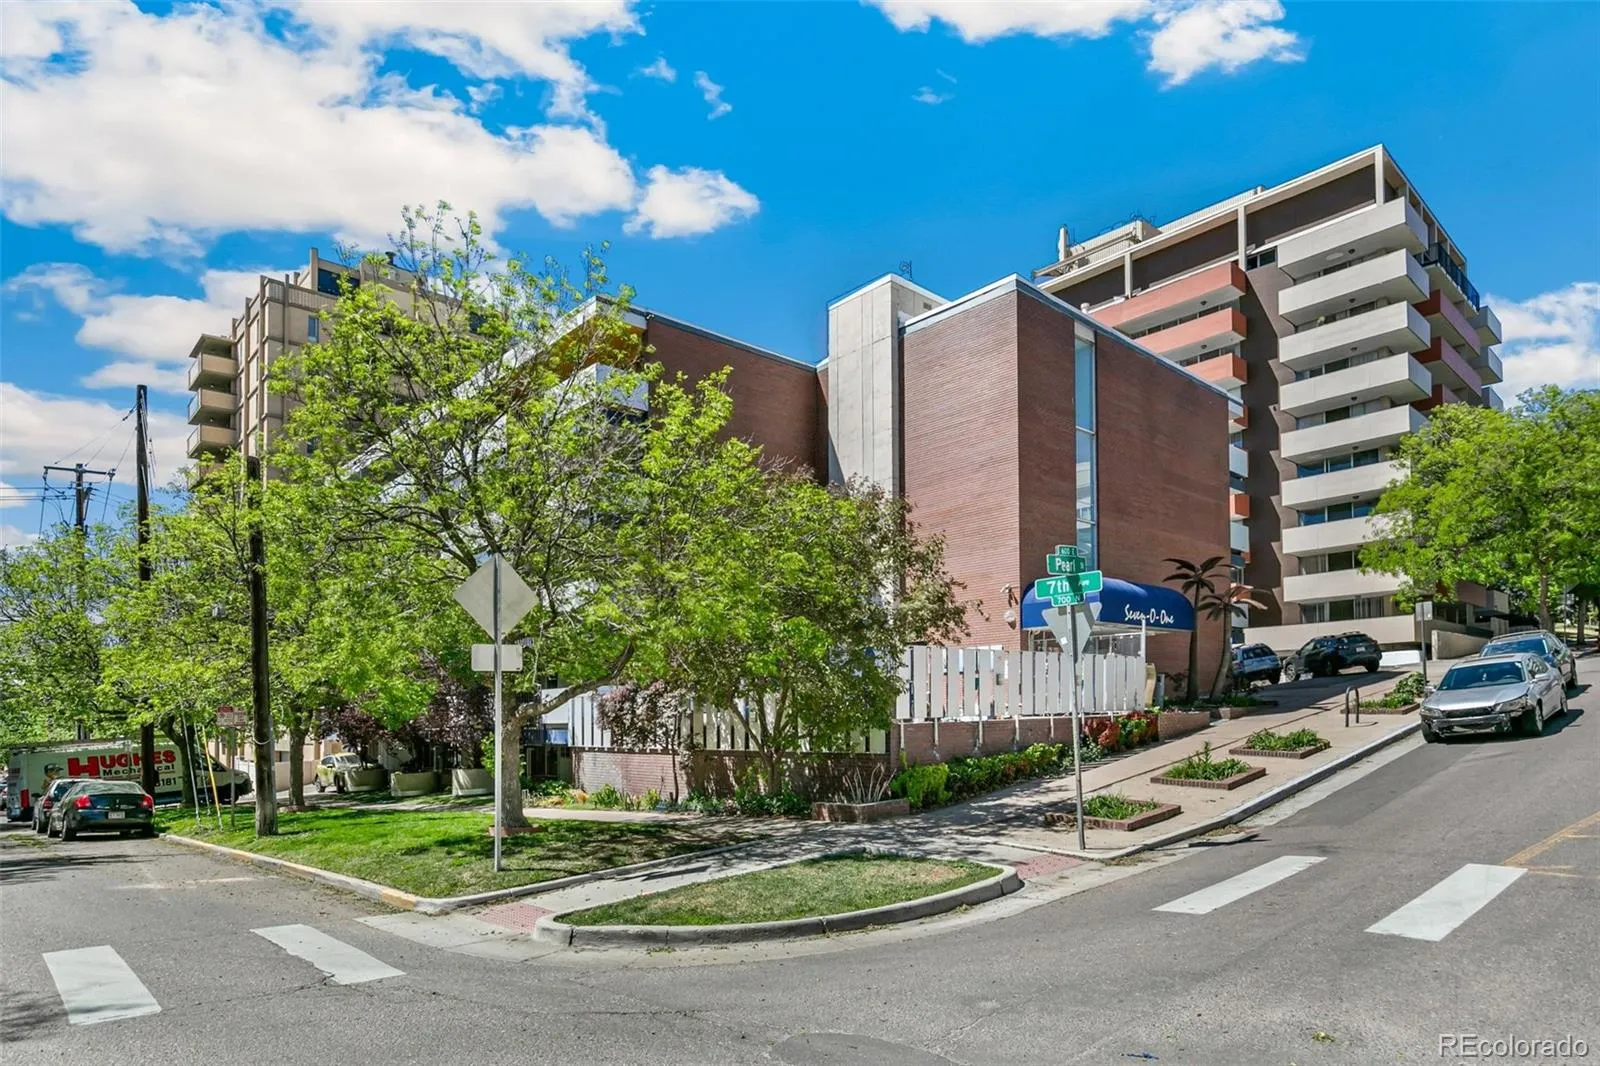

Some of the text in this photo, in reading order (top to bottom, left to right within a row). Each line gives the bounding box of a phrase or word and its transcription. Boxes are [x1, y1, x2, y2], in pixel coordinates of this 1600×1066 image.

[1055, 557, 1076, 572] Pearl
[1046, 580, 1070, 595] 7th
[1056, 596, 1072, 604] 700
[102, 763, 175, 777] Mechacal
